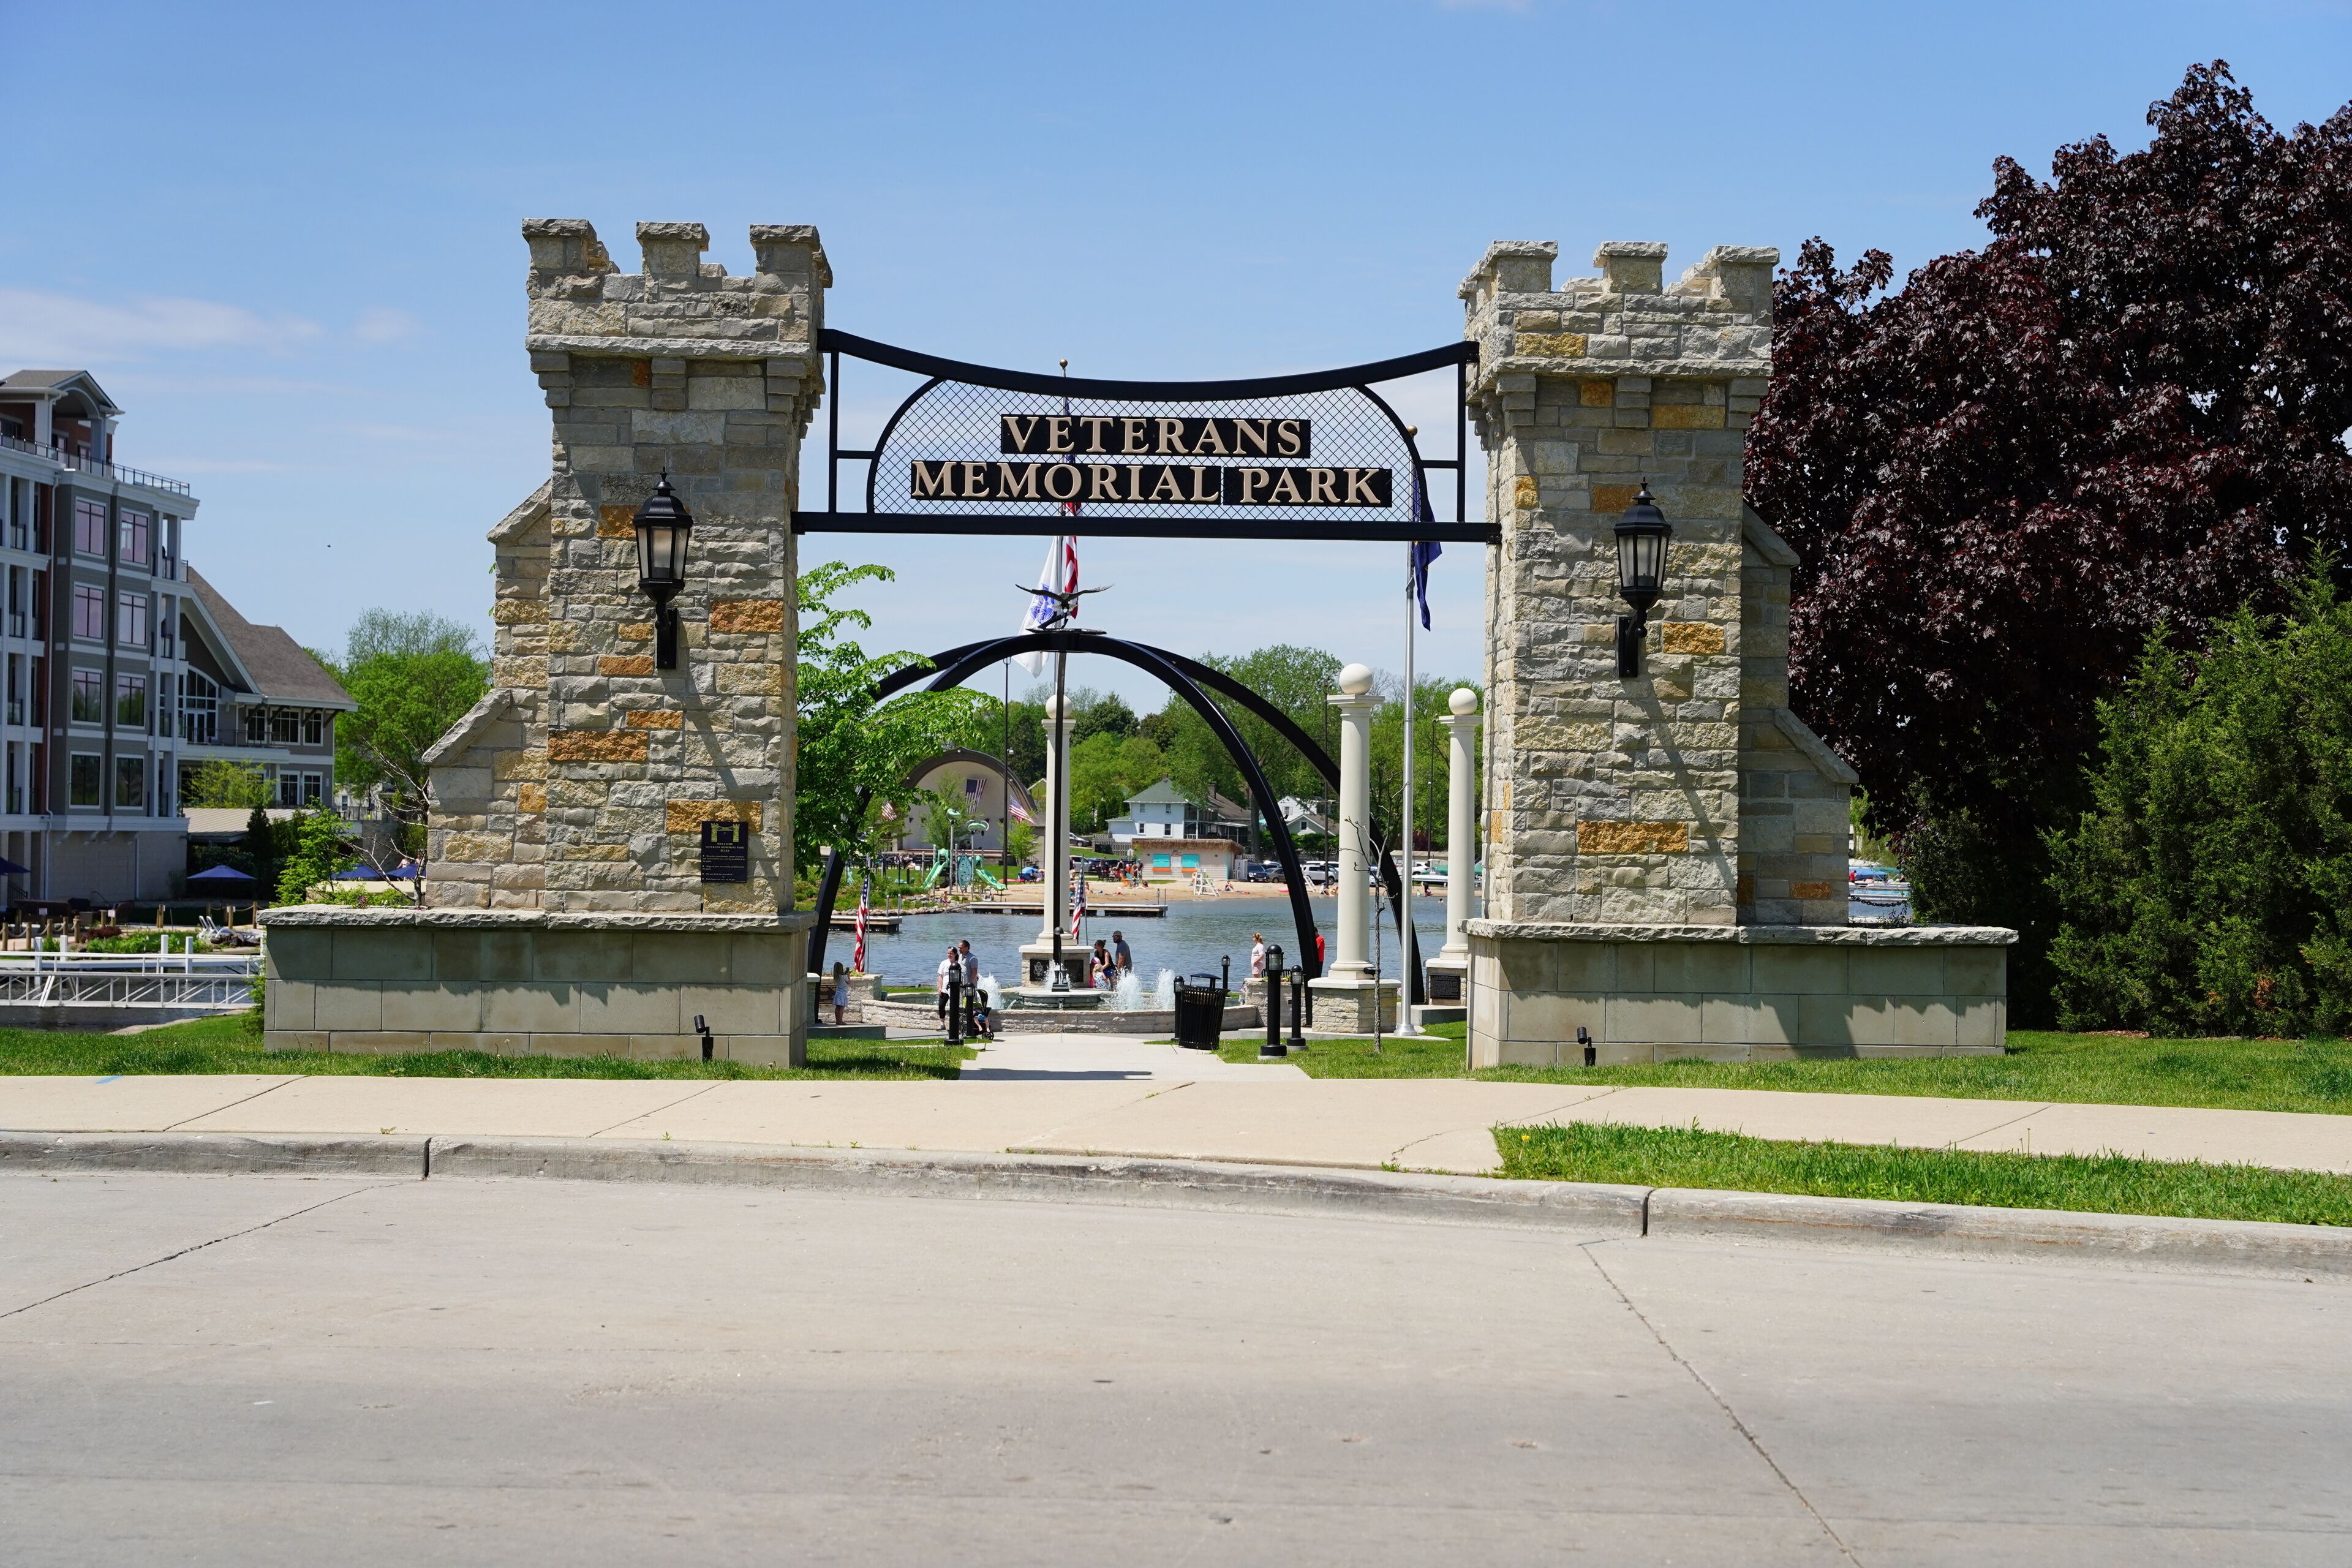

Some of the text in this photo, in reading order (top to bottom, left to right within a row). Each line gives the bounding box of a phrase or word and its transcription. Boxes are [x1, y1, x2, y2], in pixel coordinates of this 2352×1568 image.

[1003, 417, 1302, 456] VETERANS
[911, 461, 1381, 504] MEMORIAL PARK
